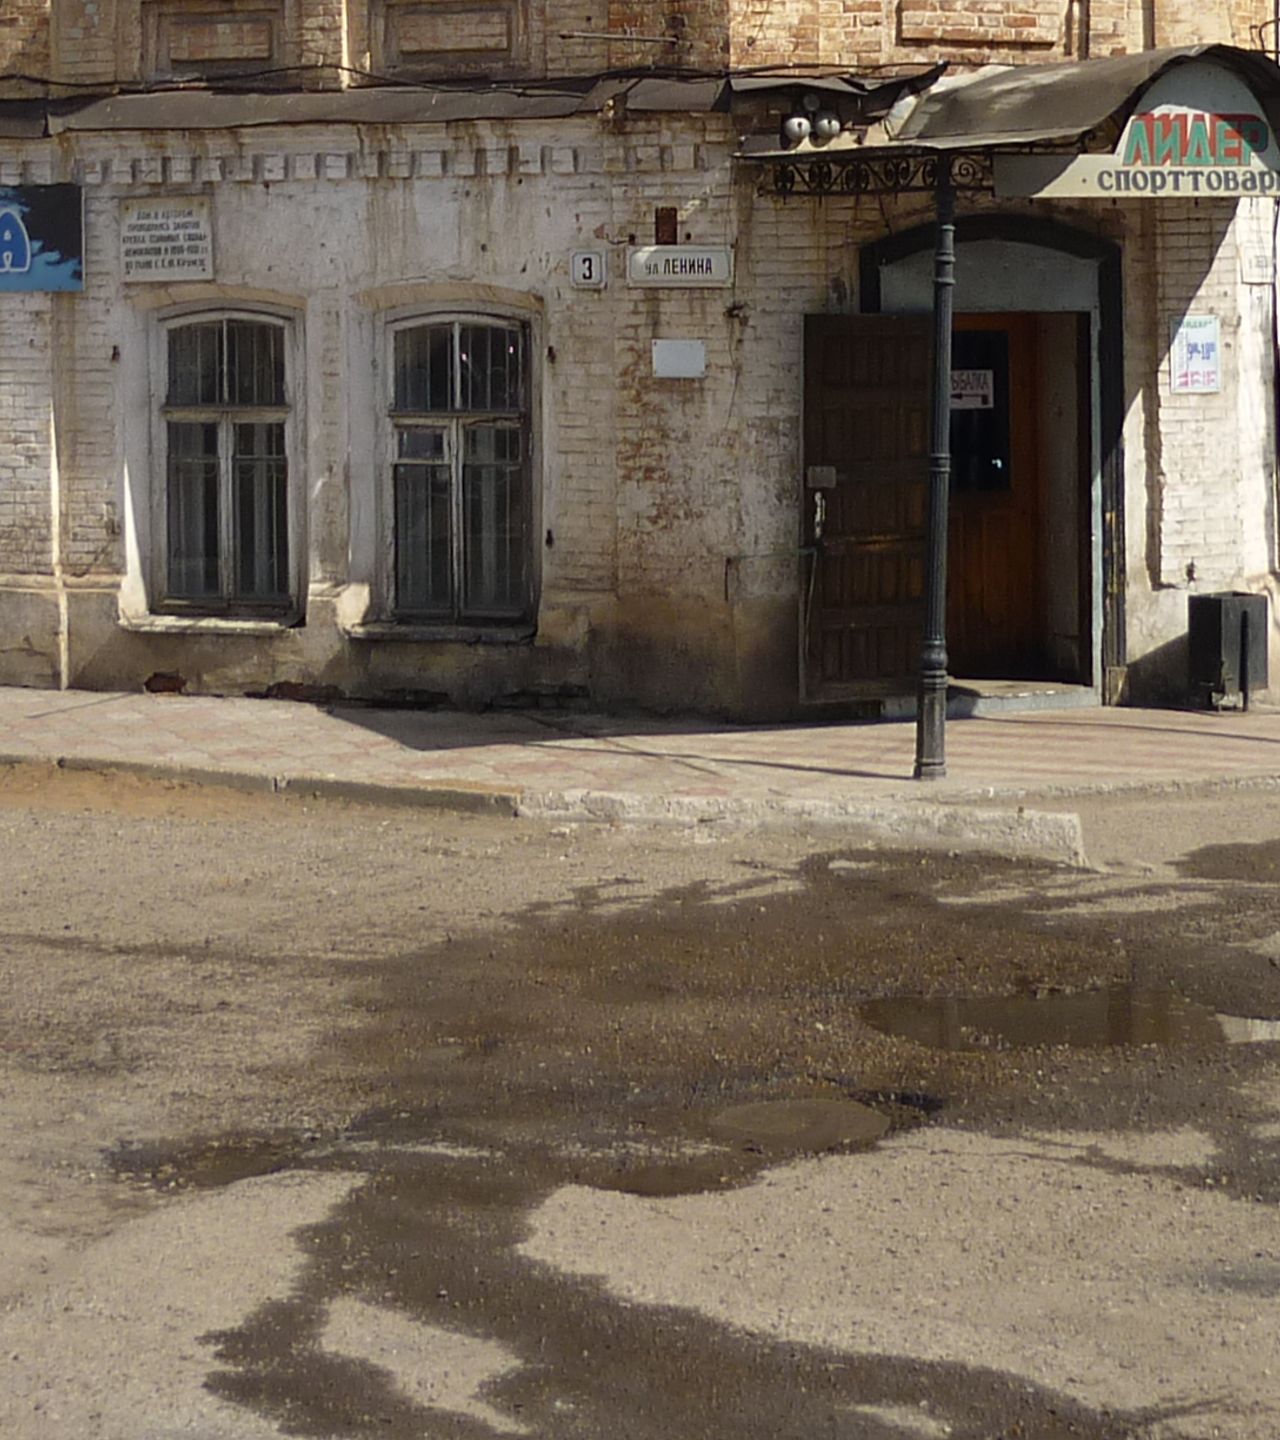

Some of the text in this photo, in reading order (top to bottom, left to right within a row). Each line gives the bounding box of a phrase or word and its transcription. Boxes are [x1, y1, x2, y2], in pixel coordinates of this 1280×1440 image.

[1122, 113, 1269, 167] ЛИДЕР
[582, 257, 593, 280] 3
[645, 258, 713, 276] ул ЛЕНИНА
[951, 371, 990, 391] ЫБАЛКА
